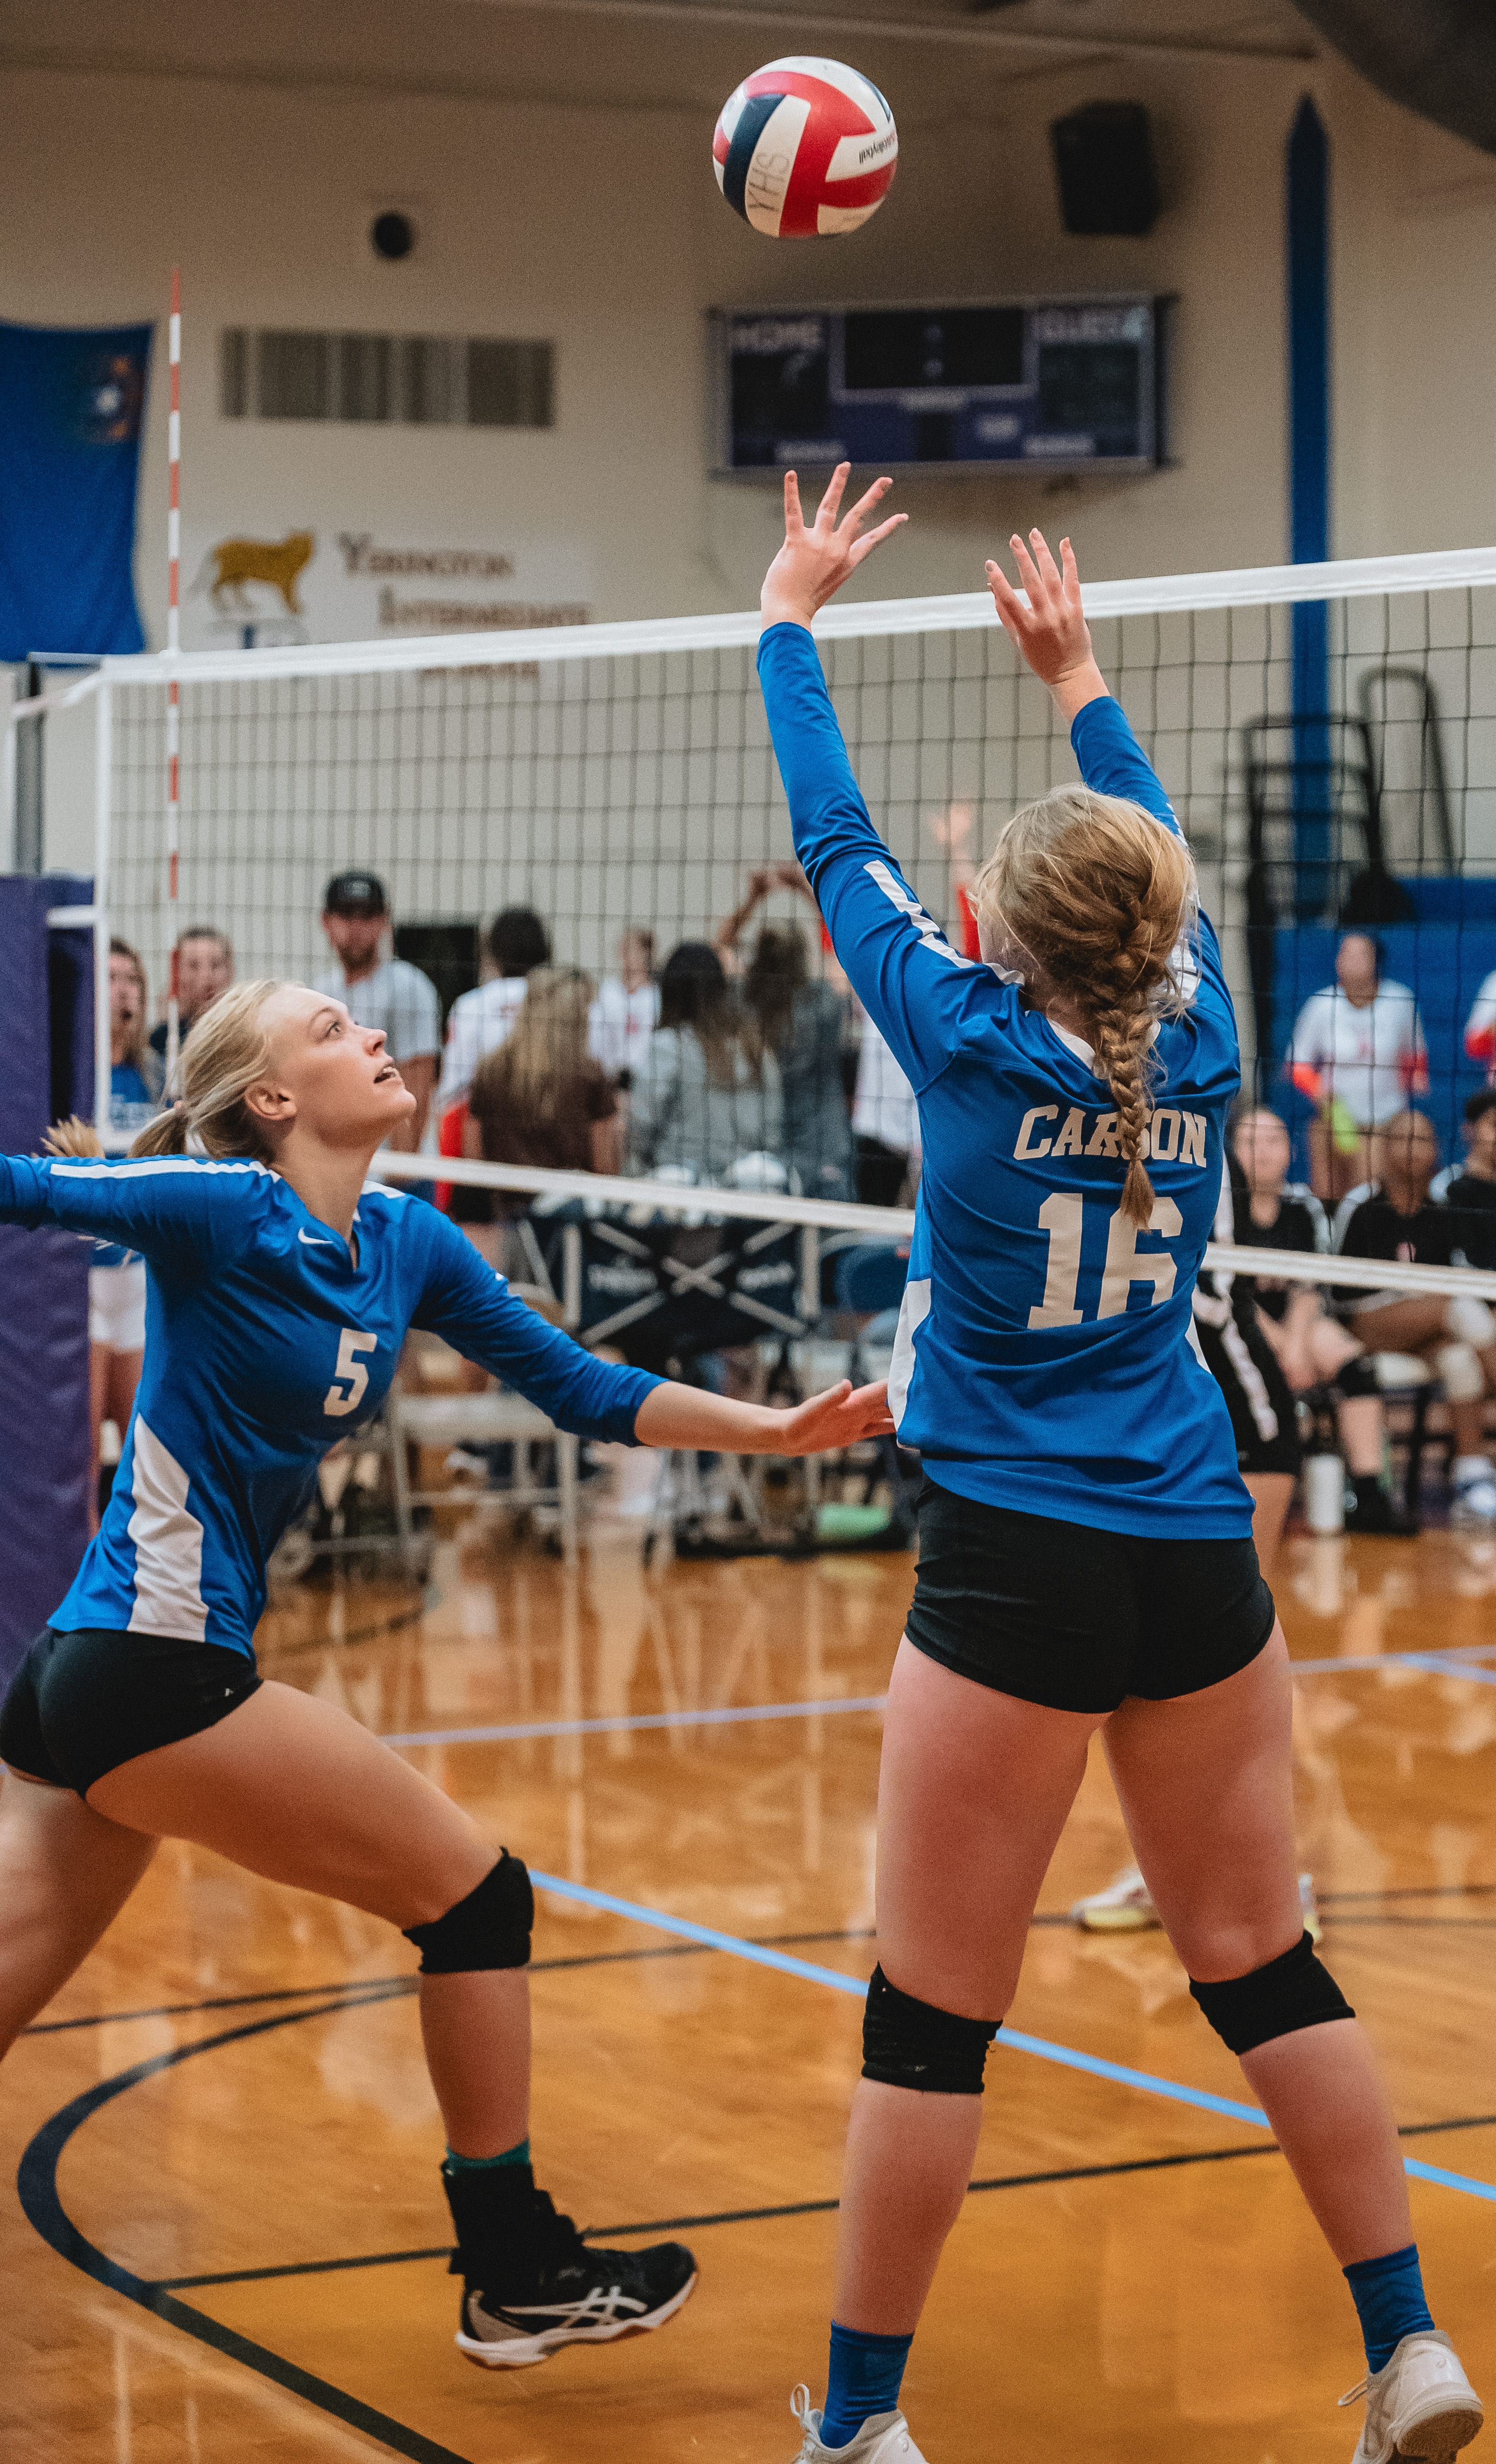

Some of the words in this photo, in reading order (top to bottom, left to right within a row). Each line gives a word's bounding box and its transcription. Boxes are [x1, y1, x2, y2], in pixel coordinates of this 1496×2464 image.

[748, 152, 790, 213] YHS
[1027, 1192, 1184, 1330] 16
[323, 1327, 377, 1416] 5
